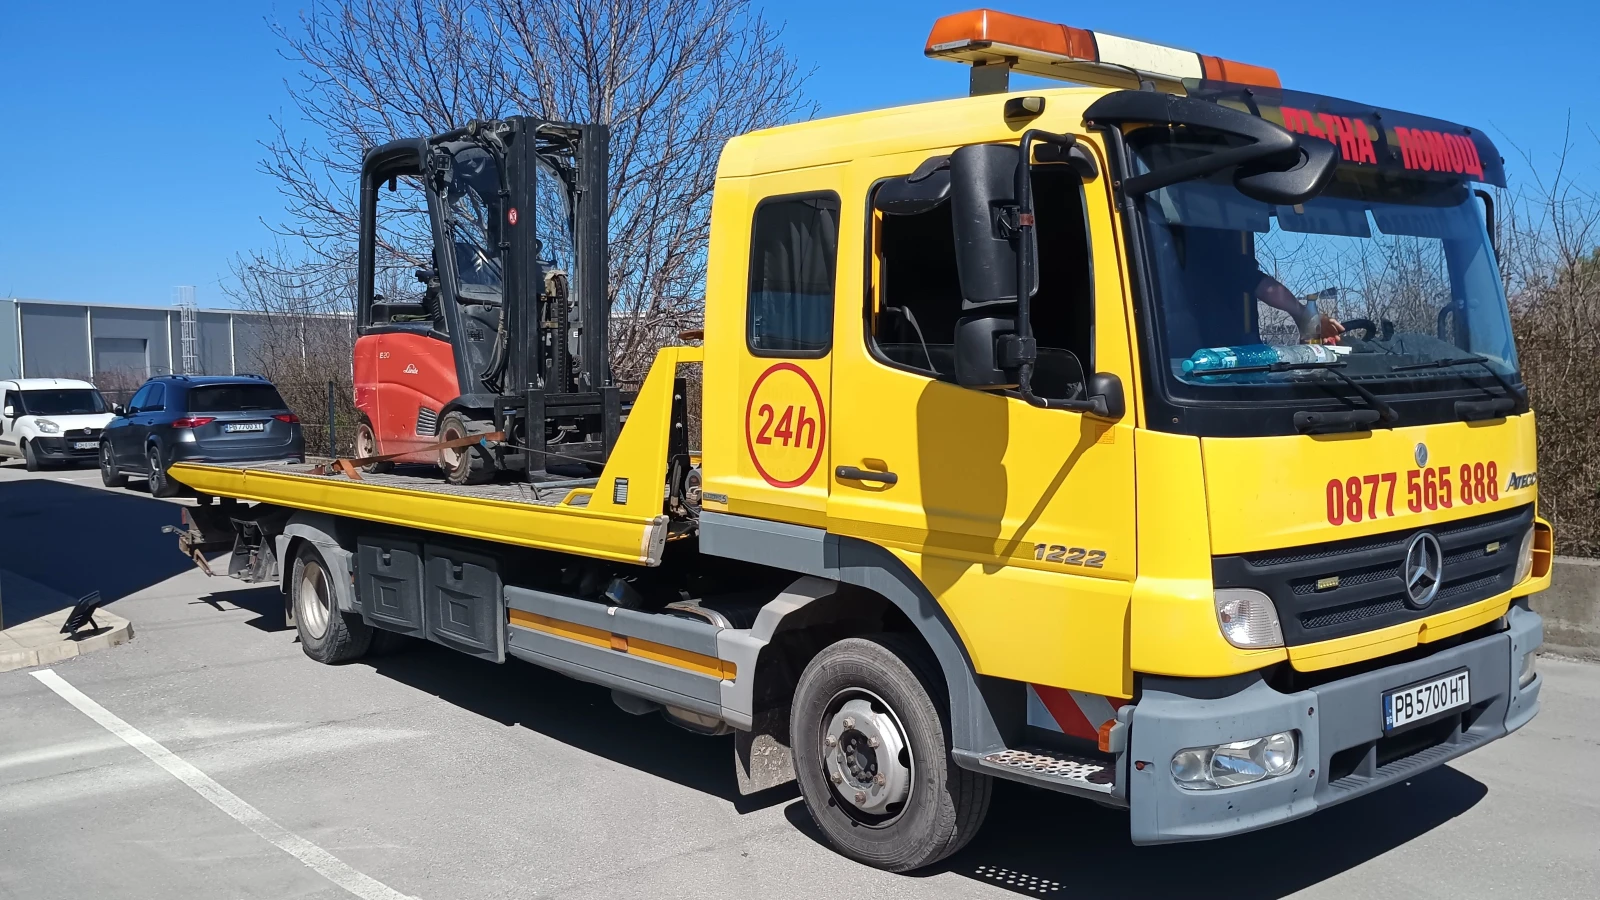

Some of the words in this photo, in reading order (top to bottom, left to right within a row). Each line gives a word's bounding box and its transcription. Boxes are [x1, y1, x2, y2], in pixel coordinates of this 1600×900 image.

[1394, 126, 1484, 181] ПОМОЩ
[379, 351, 391, 359] E20
[755, 403, 816, 450] 24h
[1326, 472, 1397, 526] 0877
[1407, 466, 1453, 513] 565
[1460, 461, 1499, 506] 888
[1034, 543, 1107, 569] 1222
[1395, 692, 1414, 722] PB
[1416, 681, 1448, 715] 5700
[1449, 674, 1466, 705] HT
